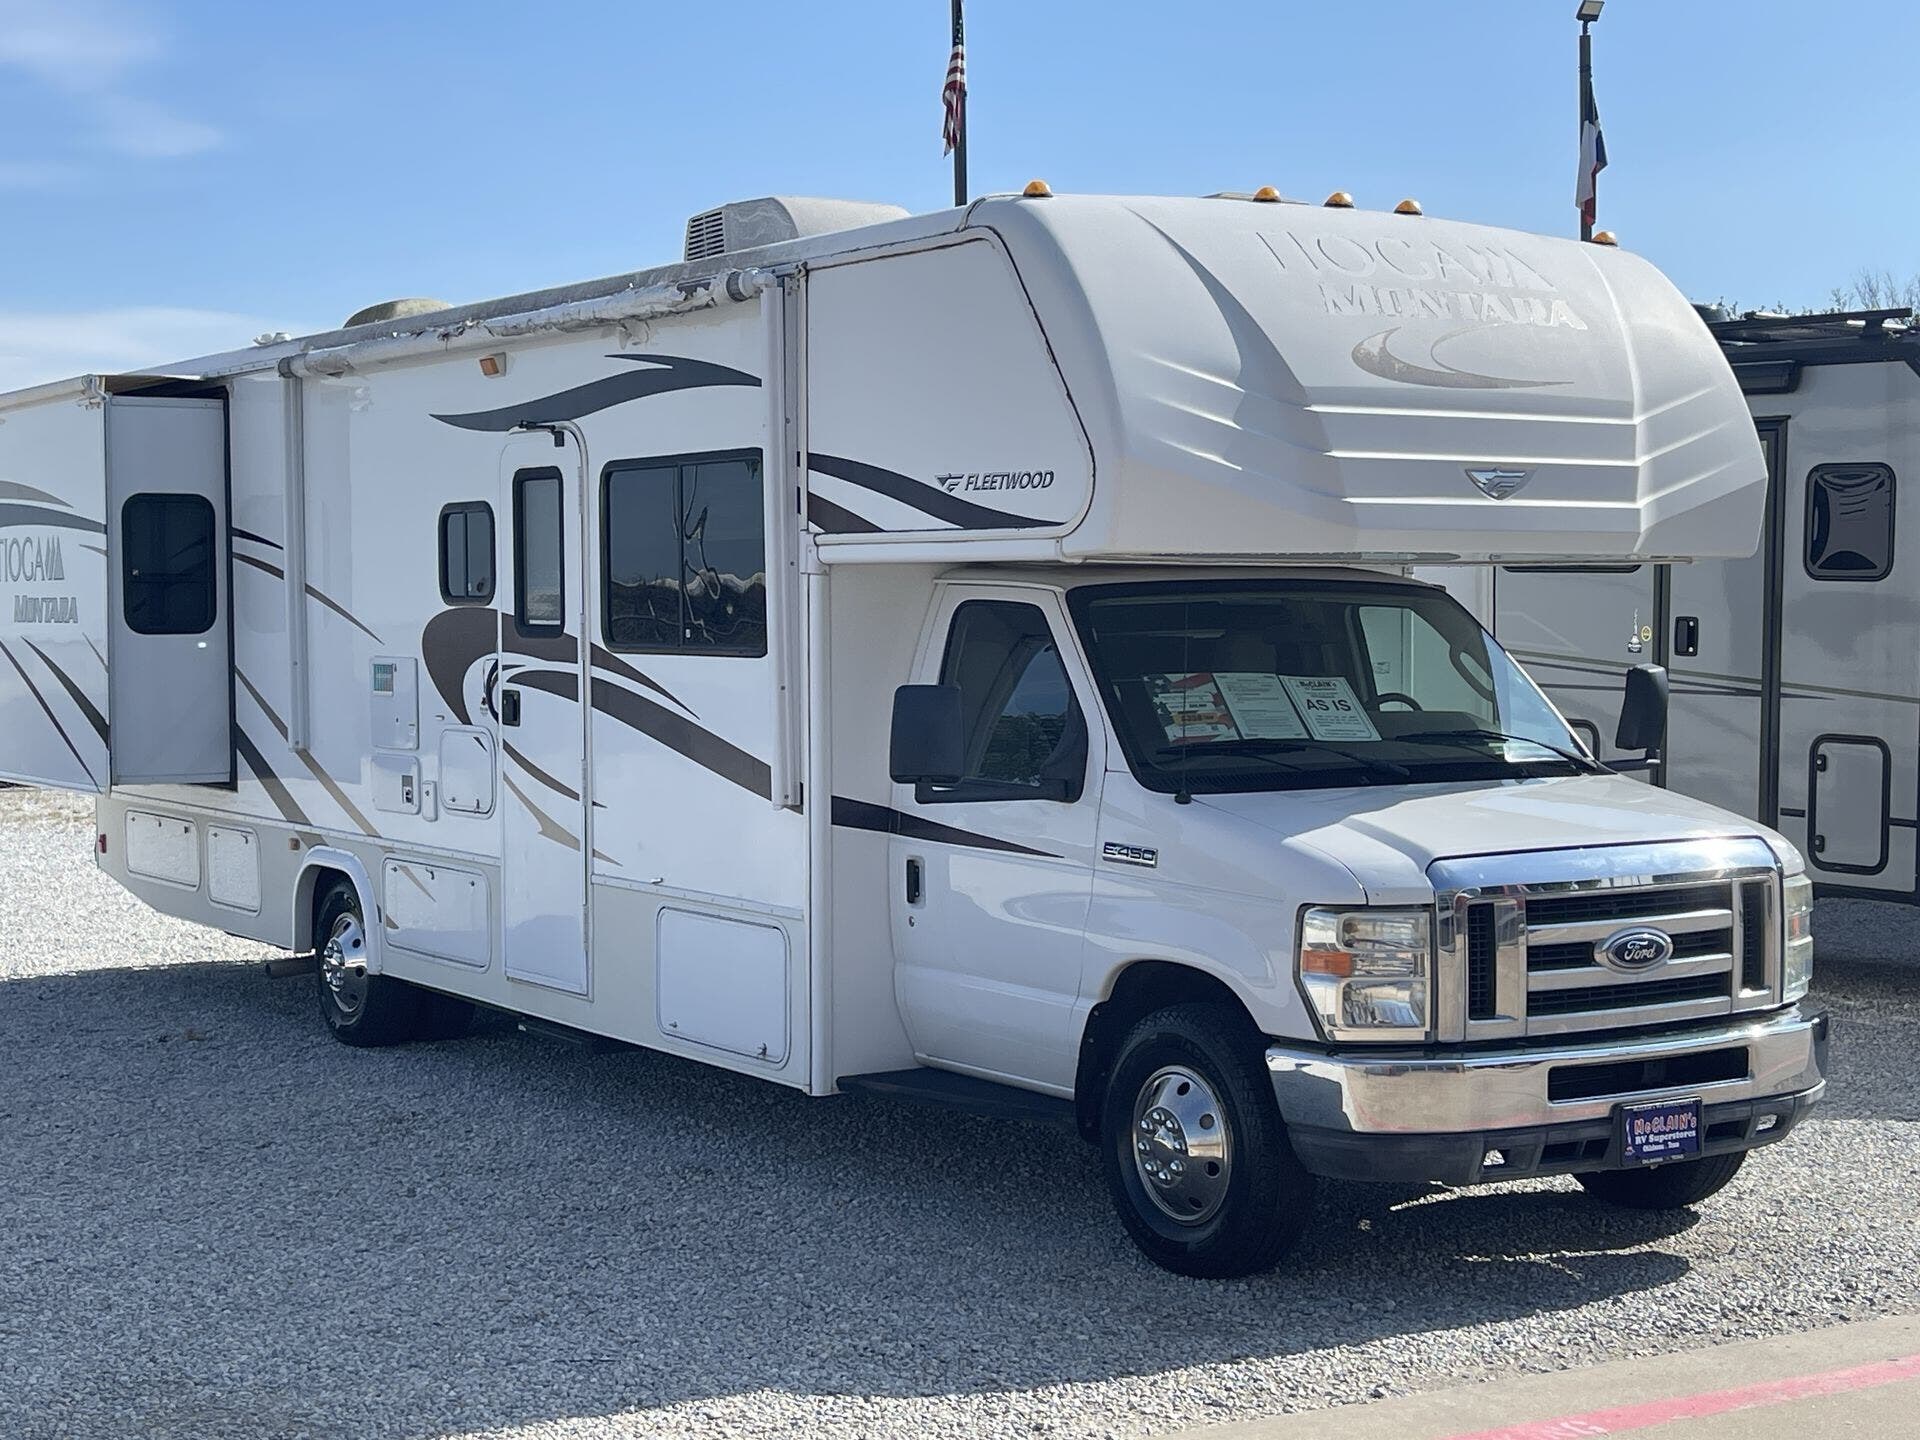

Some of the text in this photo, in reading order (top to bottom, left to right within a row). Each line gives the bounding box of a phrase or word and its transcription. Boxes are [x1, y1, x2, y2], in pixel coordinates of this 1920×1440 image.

[964, 470, 1055, 491] FLEETWOOD
[1306, 698, 1351, 712] AS IS
[1624, 940, 1657, 961] Ford
[1635, 1135, 1648, 1145] RV
